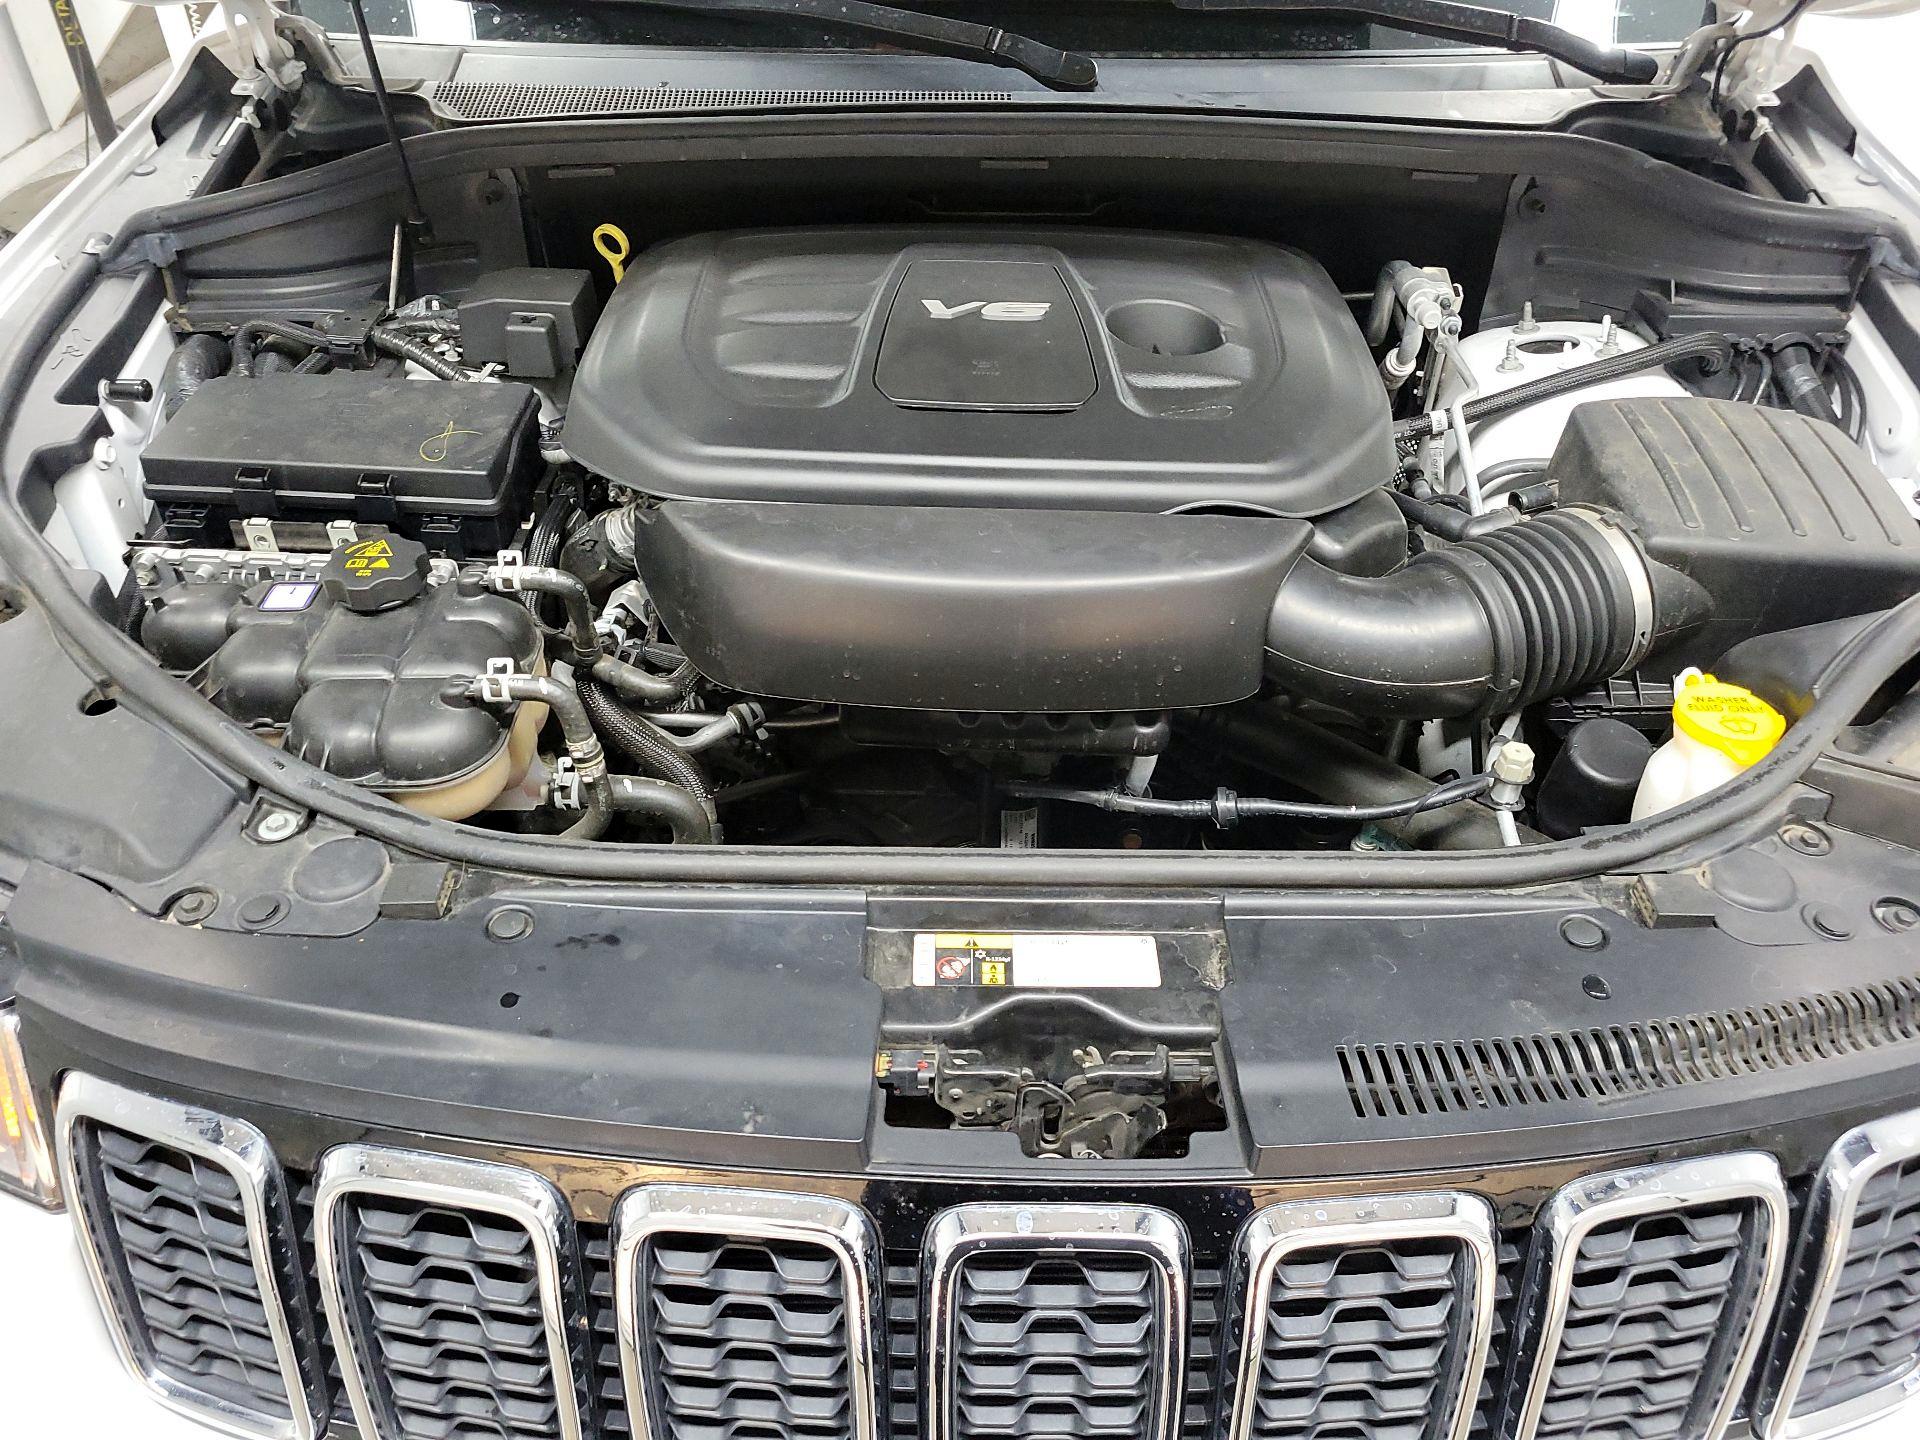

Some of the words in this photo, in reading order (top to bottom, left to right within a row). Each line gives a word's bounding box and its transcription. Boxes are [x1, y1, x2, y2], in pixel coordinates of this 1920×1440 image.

[920, 299, 1052, 322] V6
[1690, 695, 1748, 704] WASHER
[1687, 703, 1724, 712] FLUID
[1728, 704, 1765, 713] ONLY
